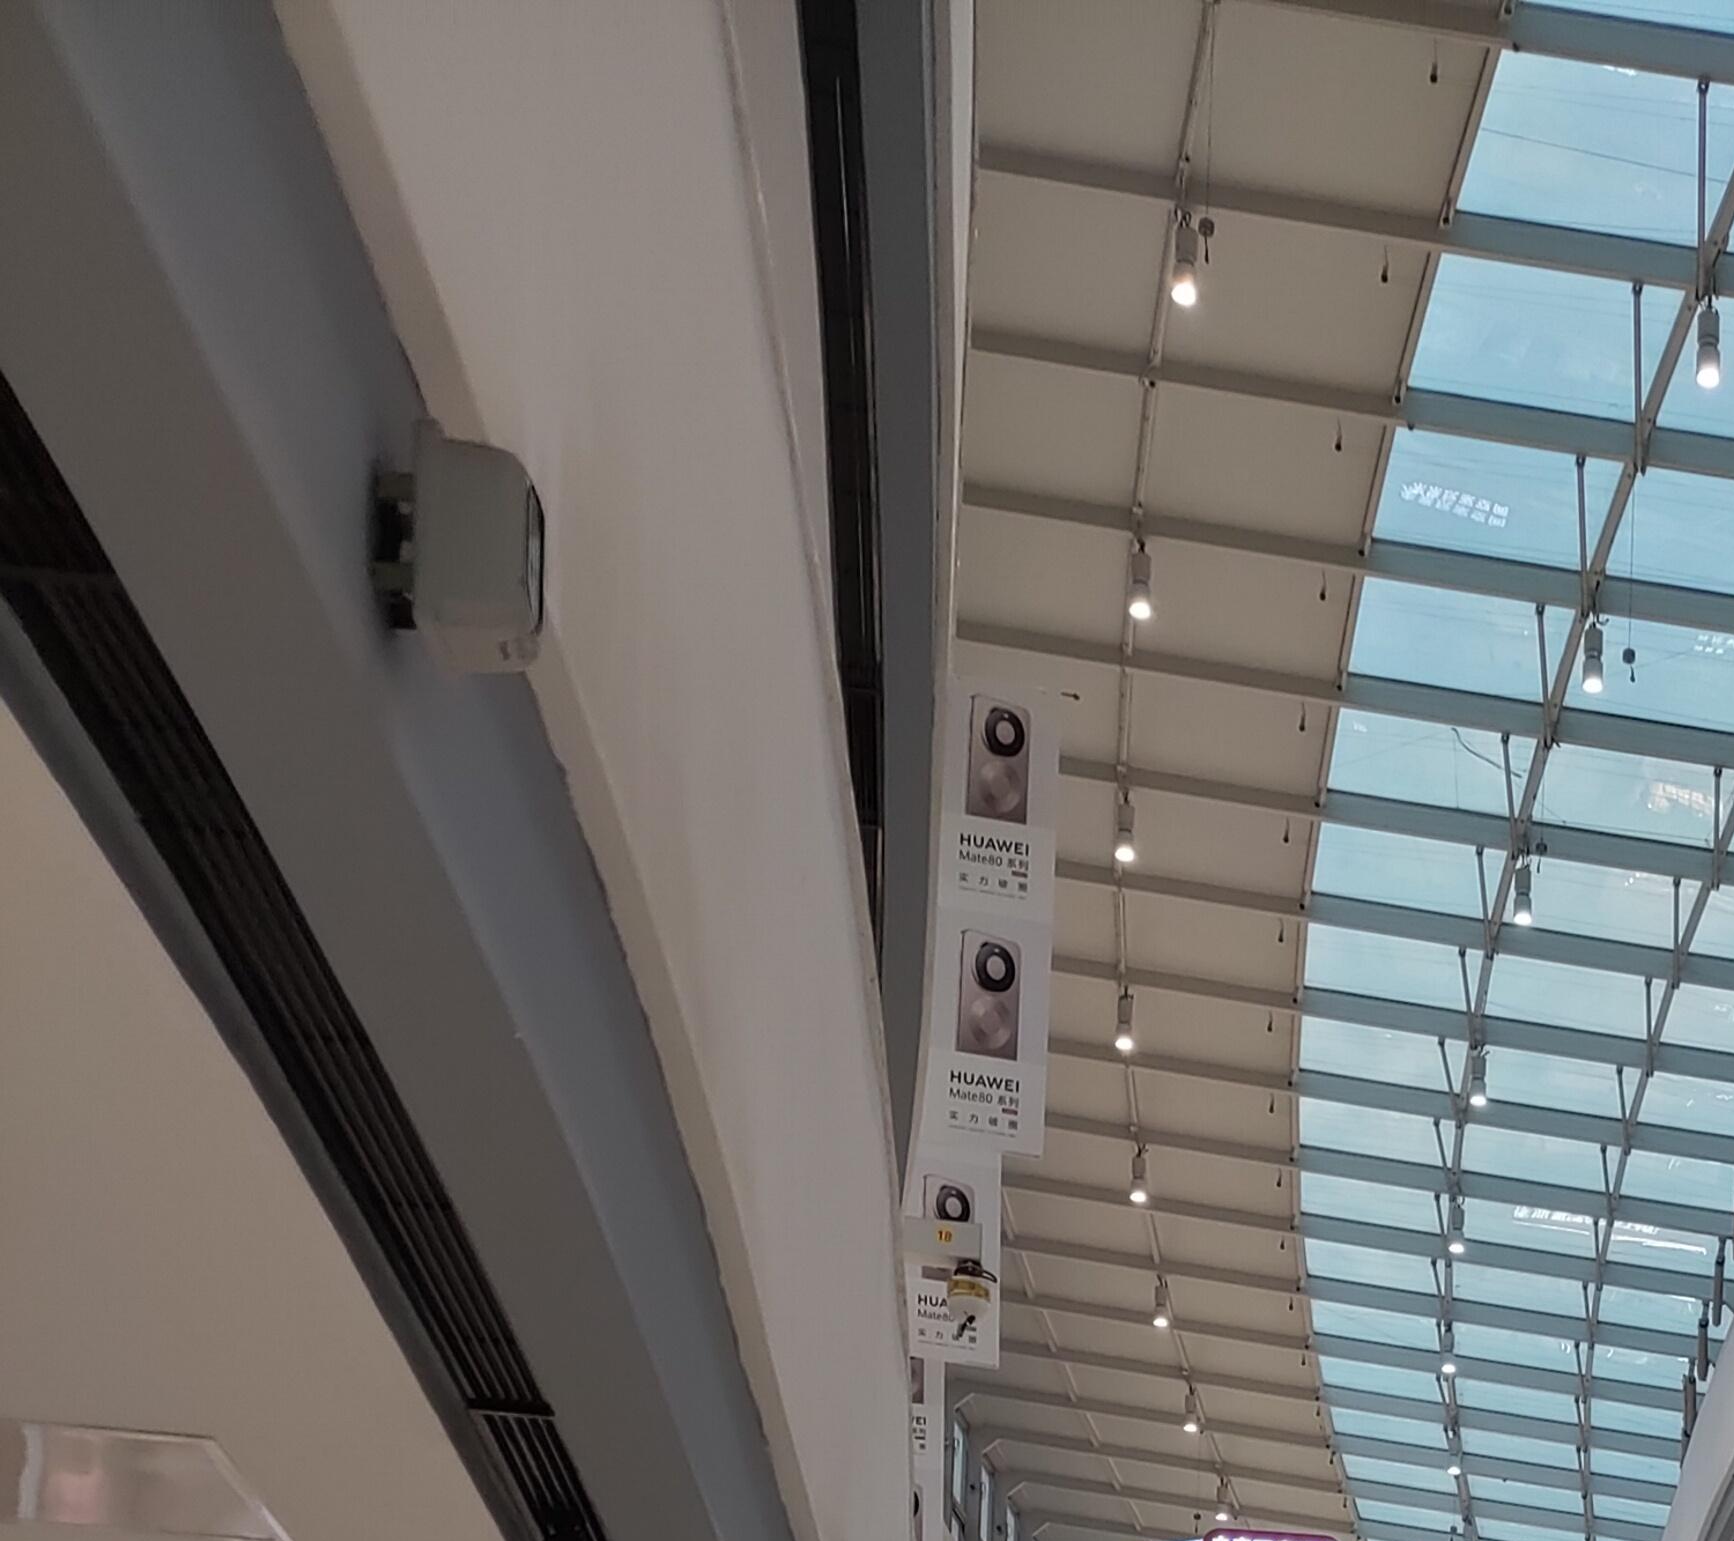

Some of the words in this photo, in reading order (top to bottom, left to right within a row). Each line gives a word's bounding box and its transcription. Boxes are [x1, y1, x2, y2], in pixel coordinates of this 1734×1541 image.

[960, 833, 1029, 857] HUAWEI
[959, 848, 1003, 867] Mate80
[950, 1070, 1020, 1093] HUAWEI
[949, 1087, 993, 1104] Mate80
